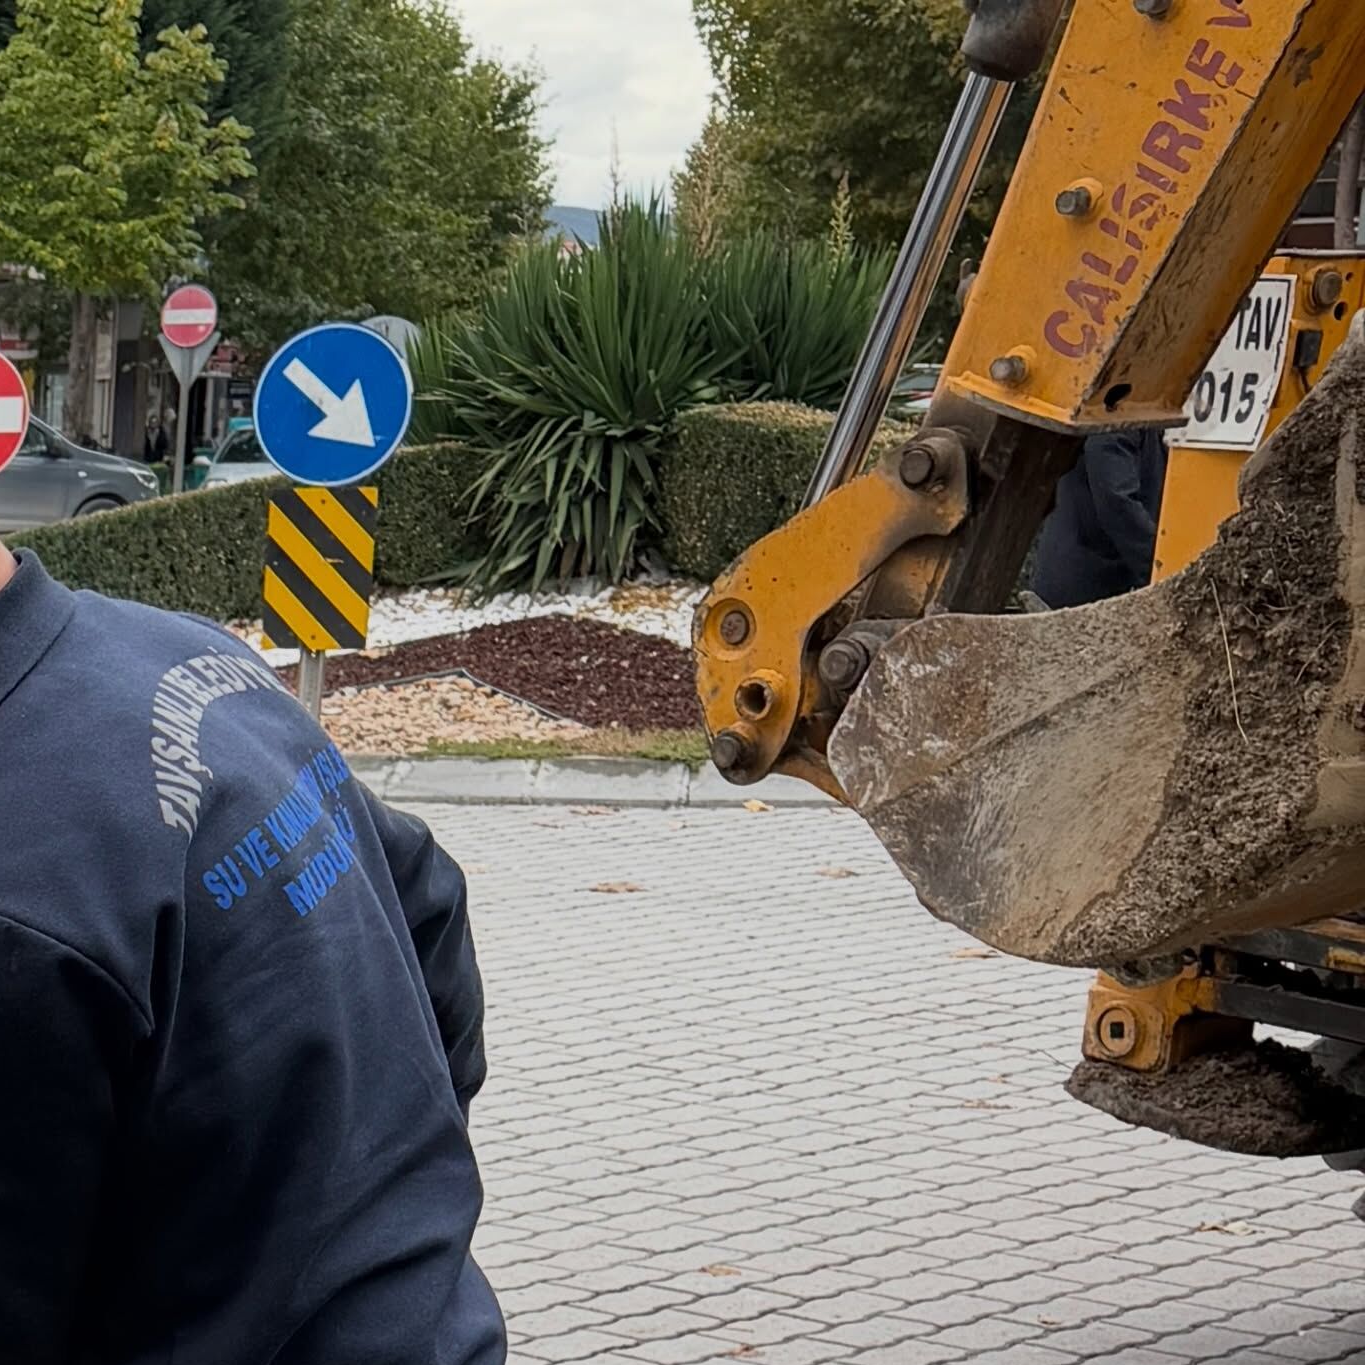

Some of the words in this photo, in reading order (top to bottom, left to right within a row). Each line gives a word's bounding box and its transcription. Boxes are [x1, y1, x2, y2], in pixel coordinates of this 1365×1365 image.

[1235, 296, 1282, 351] TAV
[202, 854, 248, 910] SU
[233, 826, 281, 879] VE
